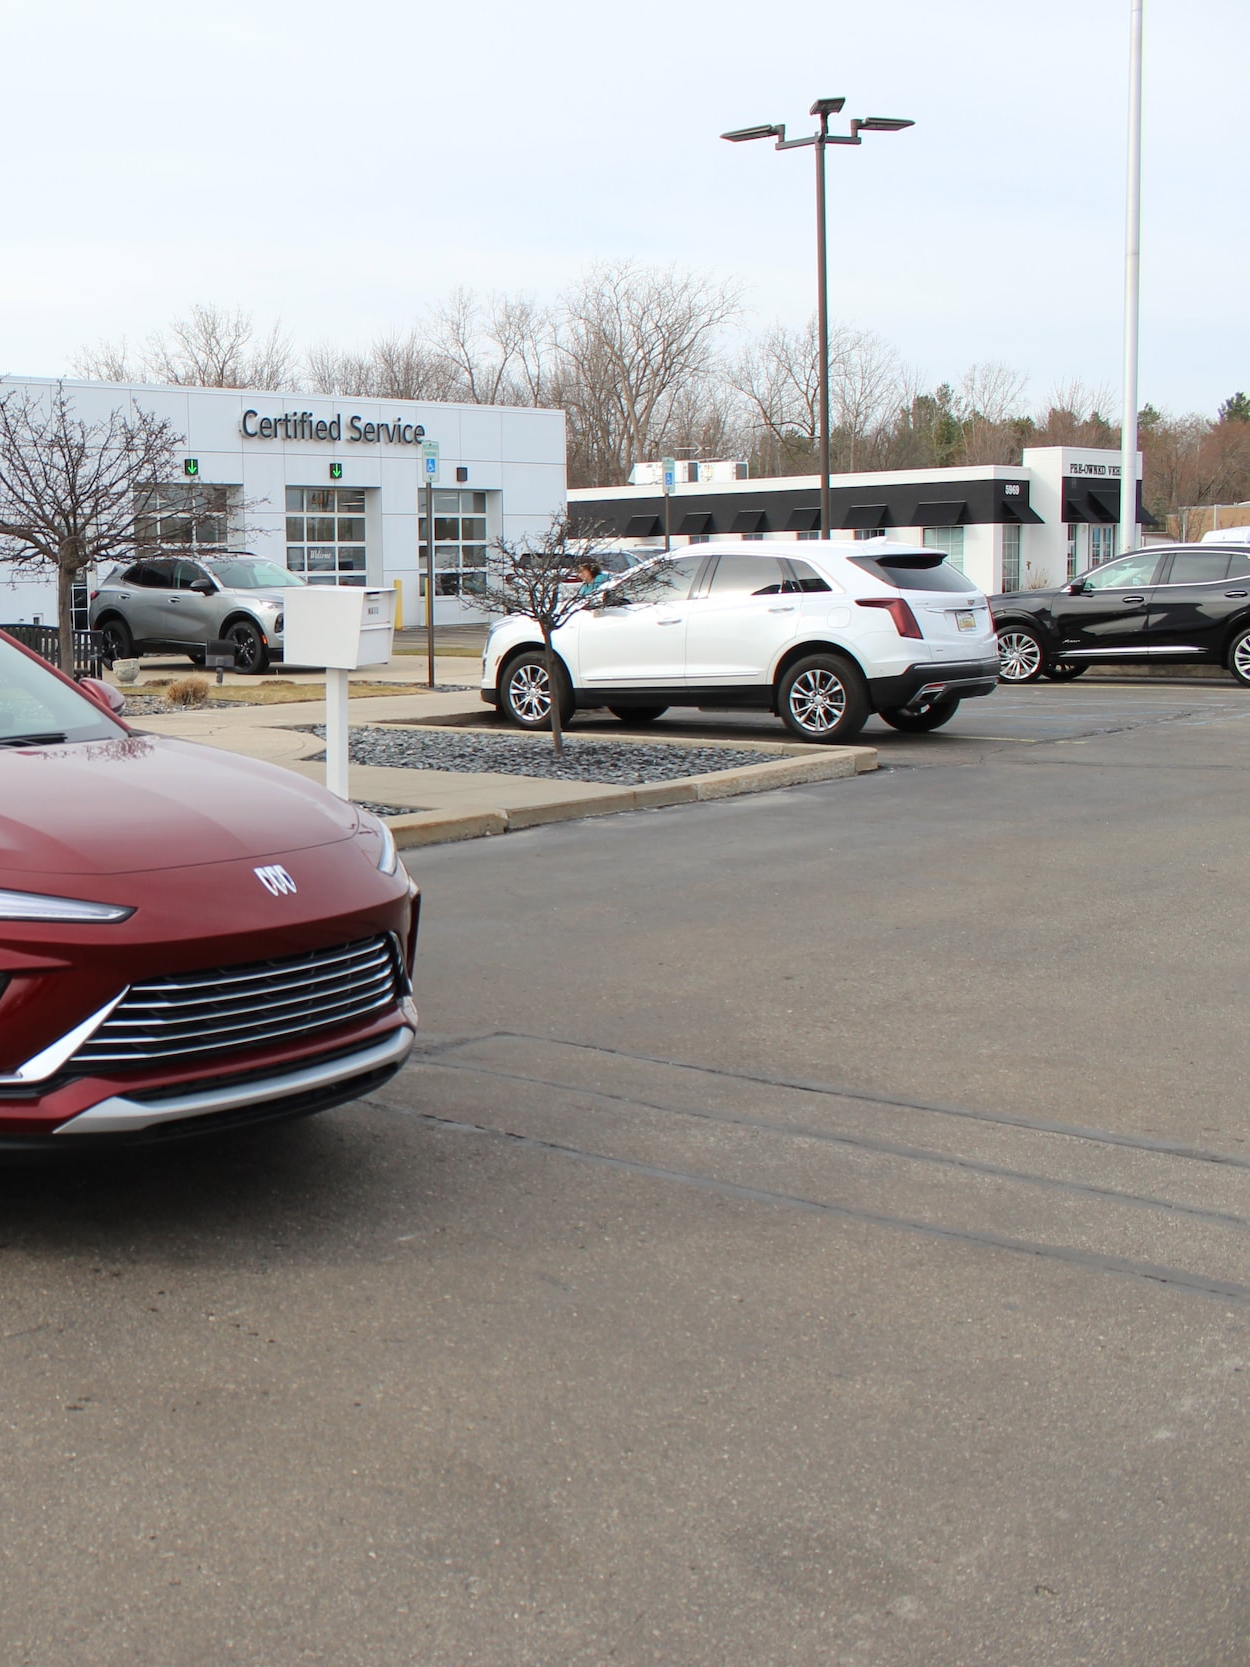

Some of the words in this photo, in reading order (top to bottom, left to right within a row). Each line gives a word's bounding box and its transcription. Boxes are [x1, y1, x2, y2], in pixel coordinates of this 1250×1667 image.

[241, 409, 341, 441] Certified
[348, 415, 426, 444] Service
[1069, 463, 1107, 475] PRE-OWNED
